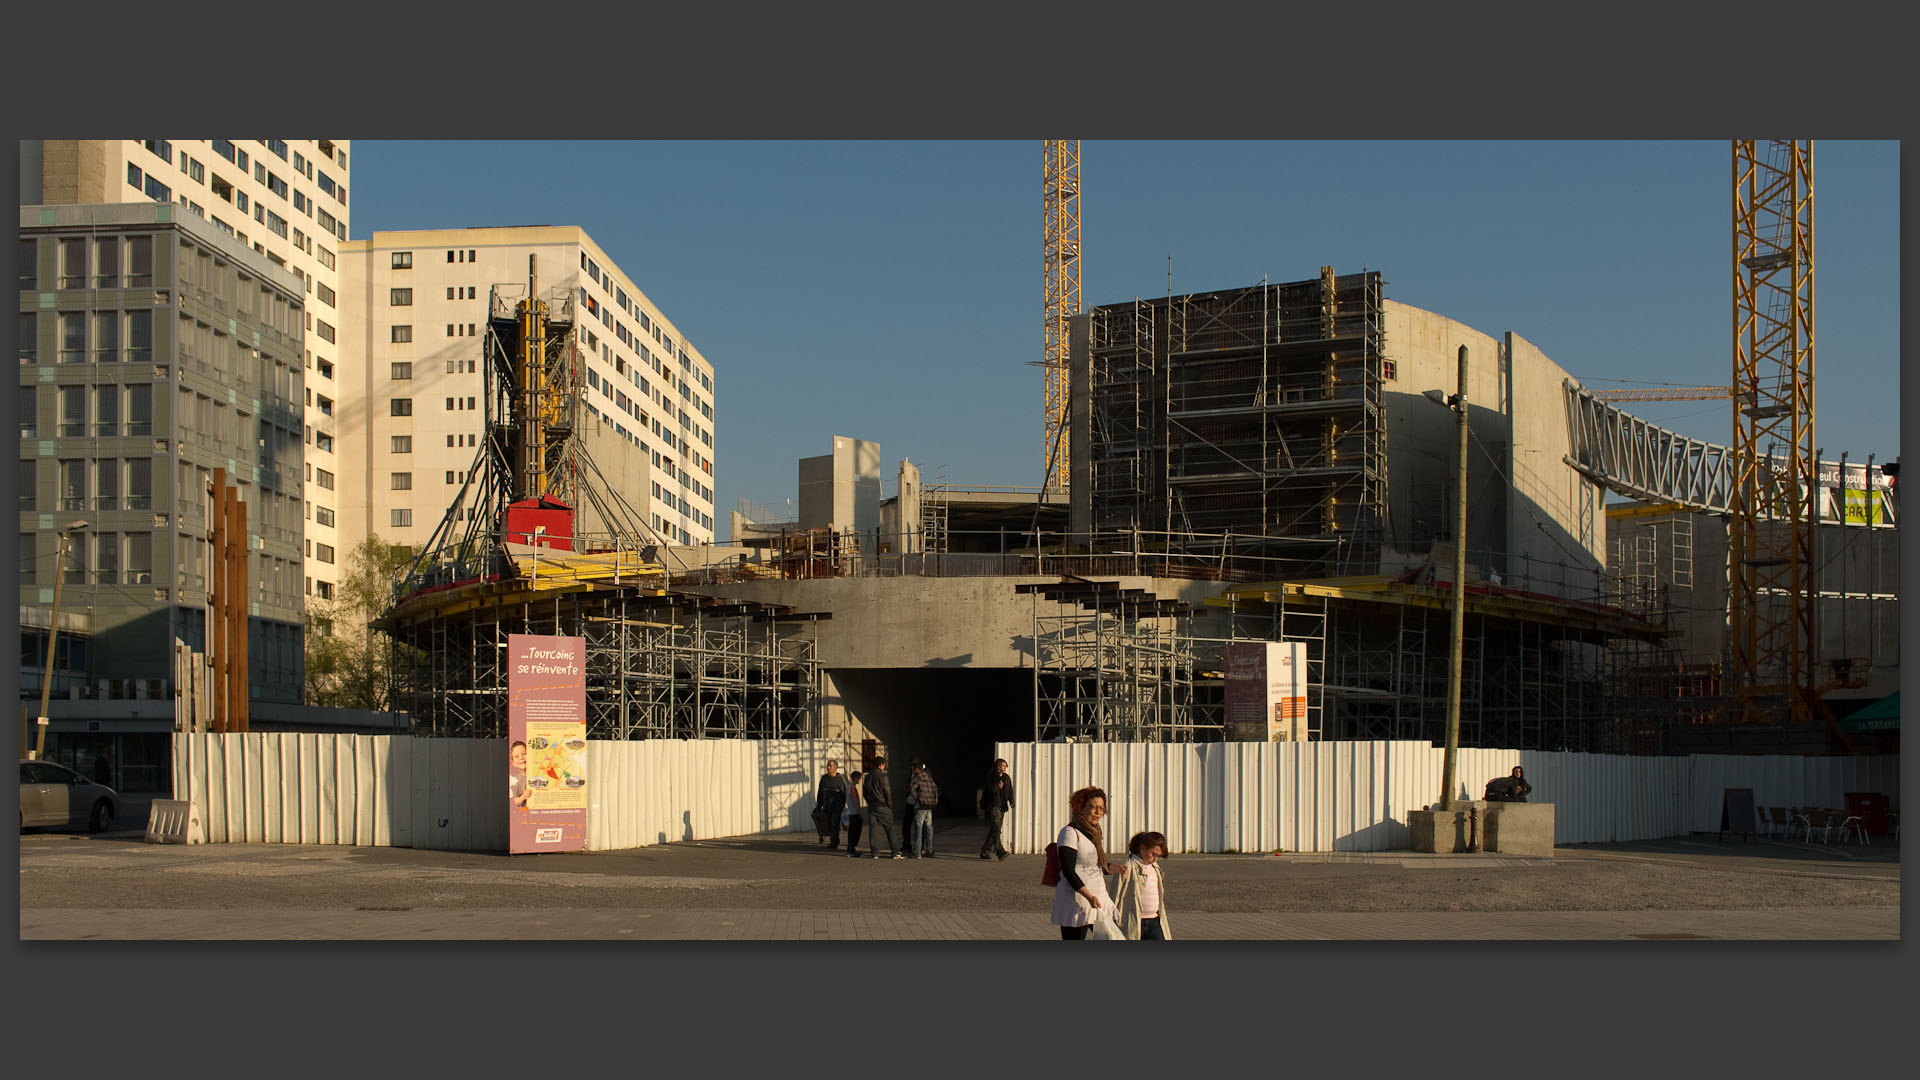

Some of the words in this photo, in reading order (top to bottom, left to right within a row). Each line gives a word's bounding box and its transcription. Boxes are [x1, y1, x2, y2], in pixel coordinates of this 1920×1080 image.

[1833, 472, 1885, 485] Cnstrution
[517, 665, 529, 674] se
[531, 662, 578, 675] réinvente
